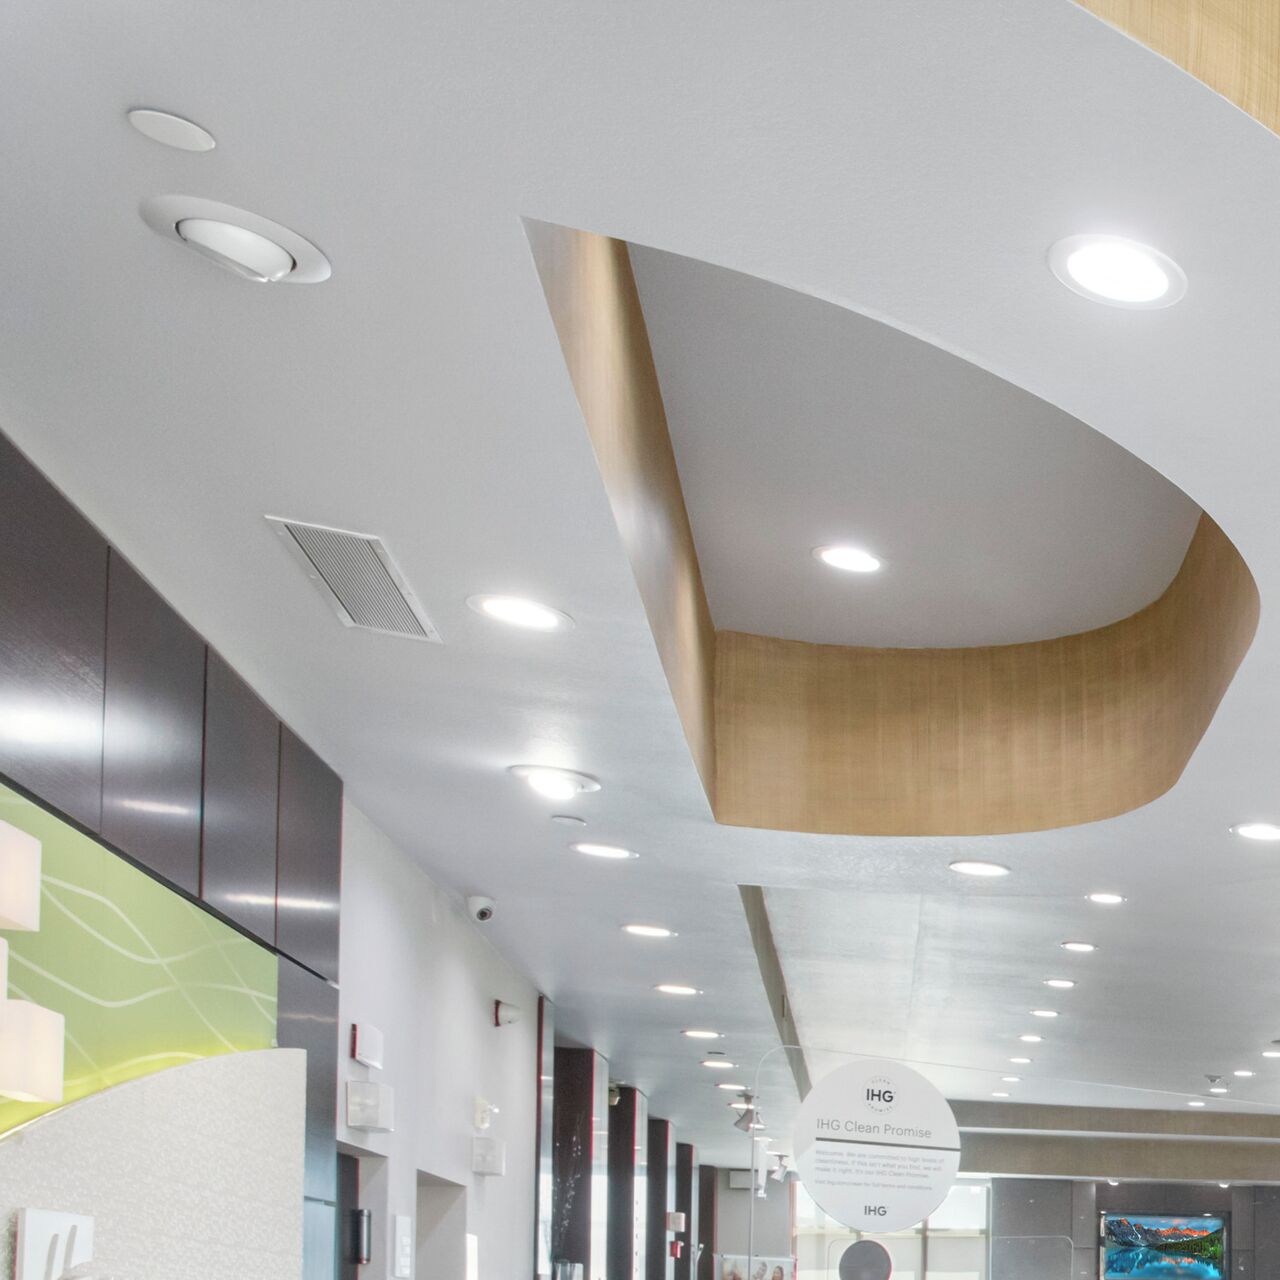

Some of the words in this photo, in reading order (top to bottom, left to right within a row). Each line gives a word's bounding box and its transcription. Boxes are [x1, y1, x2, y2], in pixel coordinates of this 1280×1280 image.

[866, 1088, 894, 1103] IHG
[816, 1118, 841, 1131] IHG
[844, 1120, 880, 1134] Clean
[884, 1123, 932, 1138] Promise
[864, 1205, 888, 1216] IHG
